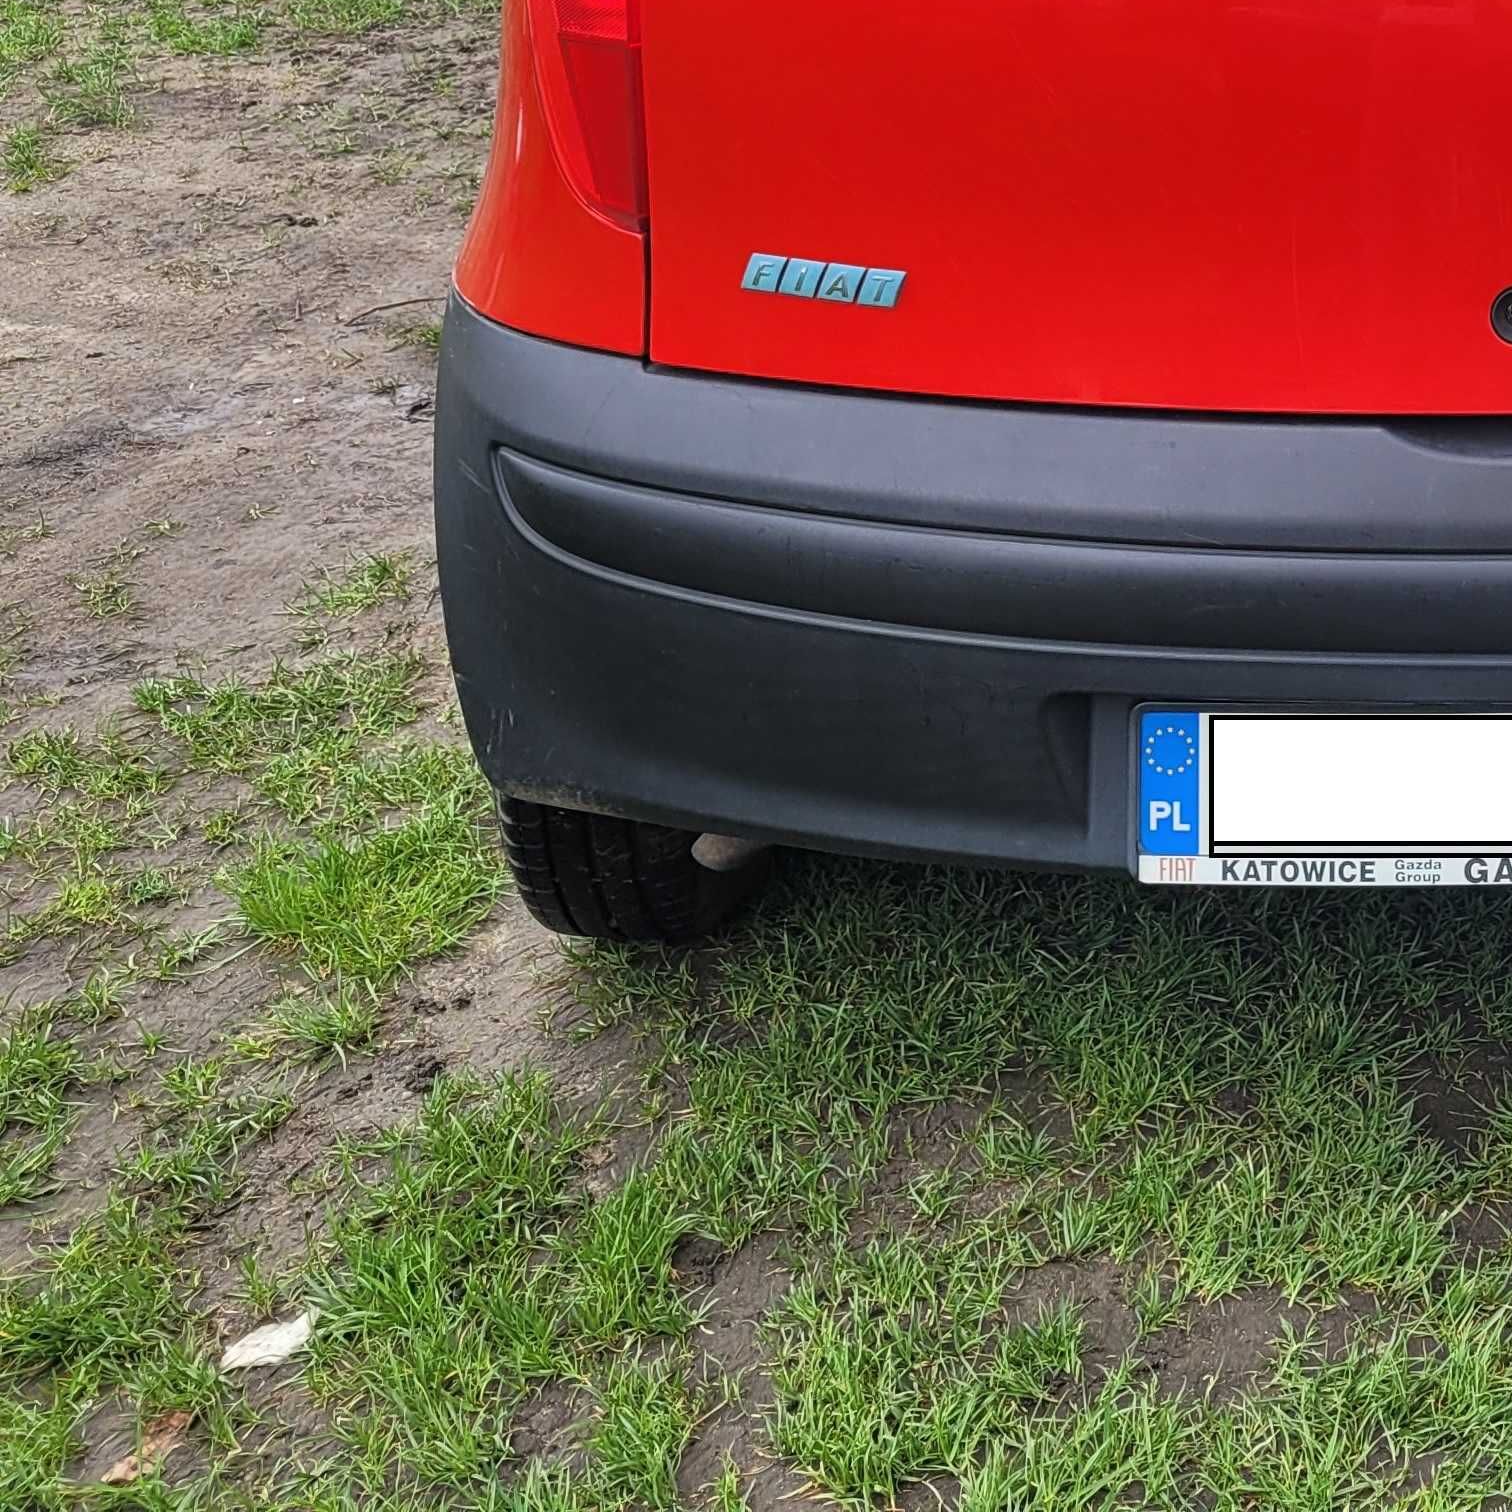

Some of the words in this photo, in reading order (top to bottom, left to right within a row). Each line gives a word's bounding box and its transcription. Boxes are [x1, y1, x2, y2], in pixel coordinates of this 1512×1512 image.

[749, 259, 898, 305] FIAT
[1149, 800, 1192, 832] PL
[1159, 857, 1197, 882] FIAT
[1222, 859, 1376, 883] KATOWICE
[1394, 858, 1443, 871] Gazda
[1394, 871, 1442, 884] Group
